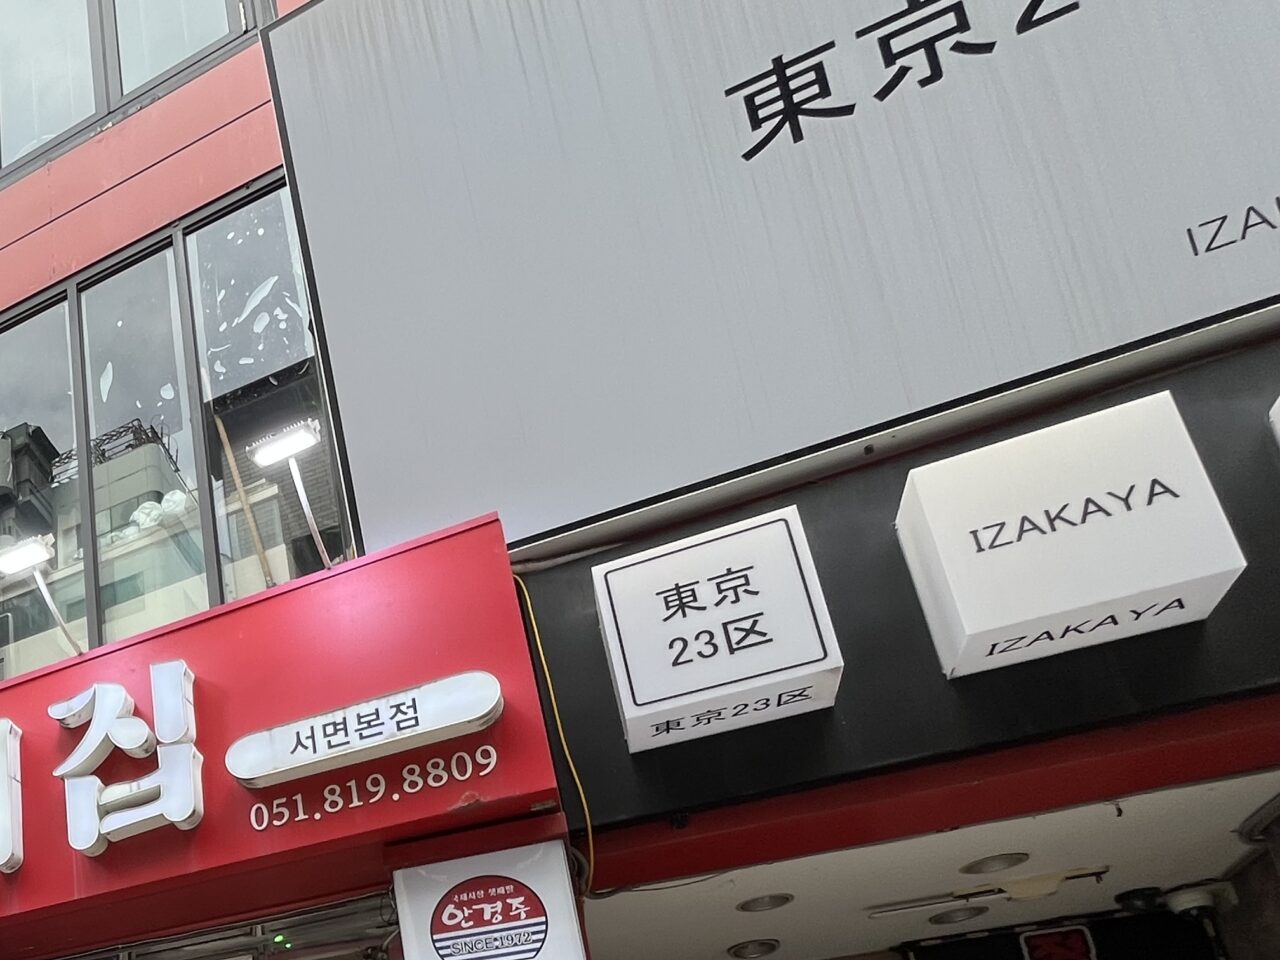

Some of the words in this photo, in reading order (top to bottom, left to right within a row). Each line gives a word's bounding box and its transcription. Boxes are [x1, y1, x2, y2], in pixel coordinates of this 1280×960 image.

[723, 0, 1082, 162] 東京
[1185, 196, 1280, 257] IZA
[970, 476, 1182, 555] IZAKAYA
[655, 563, 762, 624] 東京
[666, 612, 775, 668] 23区
[983, 597, 1188, 659] IZAKAYA
[288, 697, 424, 758] 서면본점
[648, 684, 816, 740] 東京23区
[248, 743, 501, 834] 051.819.8809
[441, 896, 531, 929] 안경주
[449, 935, 494, 956] SINCE
[498, 931, 533, 948] 1972
